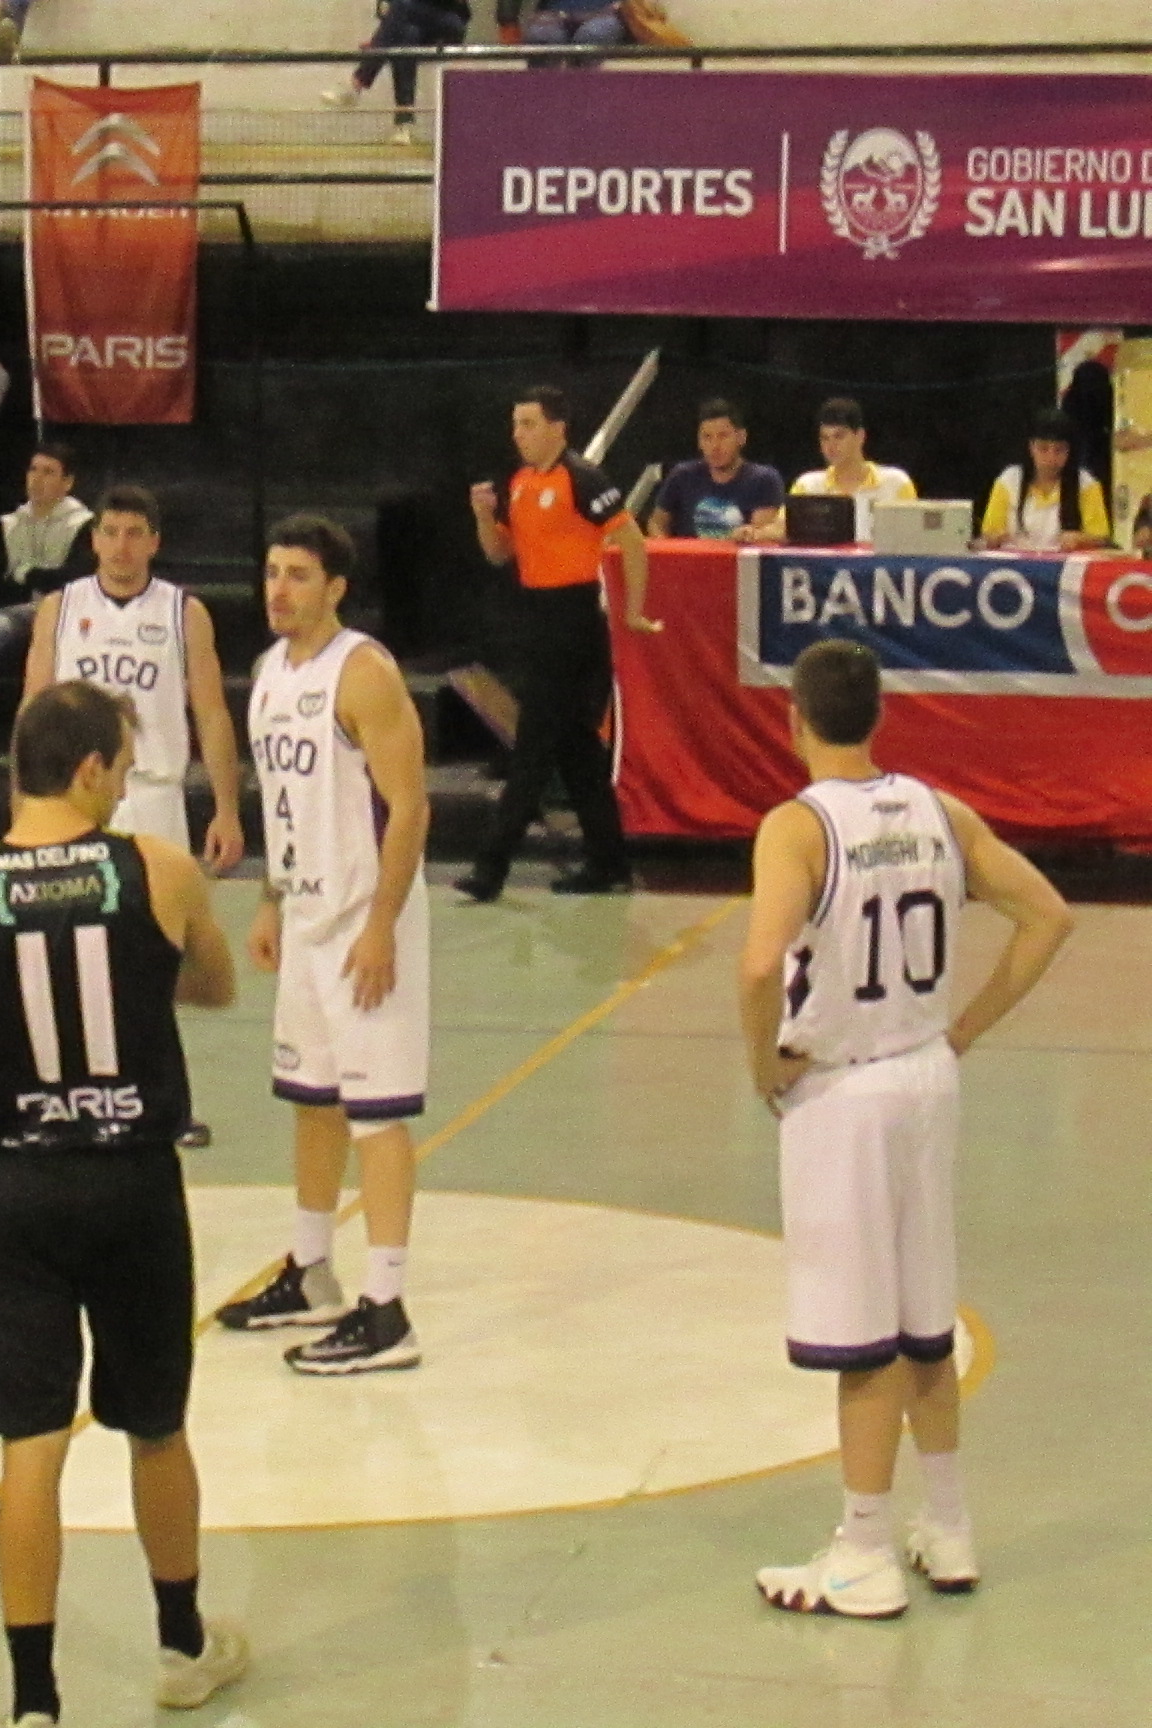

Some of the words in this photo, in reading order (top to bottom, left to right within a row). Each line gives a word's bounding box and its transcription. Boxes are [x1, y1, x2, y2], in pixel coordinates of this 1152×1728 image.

[501, 165, 755, 217] DEPORTES
[967, 146, 1131, 184] GOBIERNO
[964, 186, 1066, 238] SAN
[41, 334, 188, 369] PARIS
[780, 566, 1035, 630] BANCO
[77, 654, 159, 691] PICO
[855, 889, 945, 1001] 10
[16, 925, 119, 1083] 11
